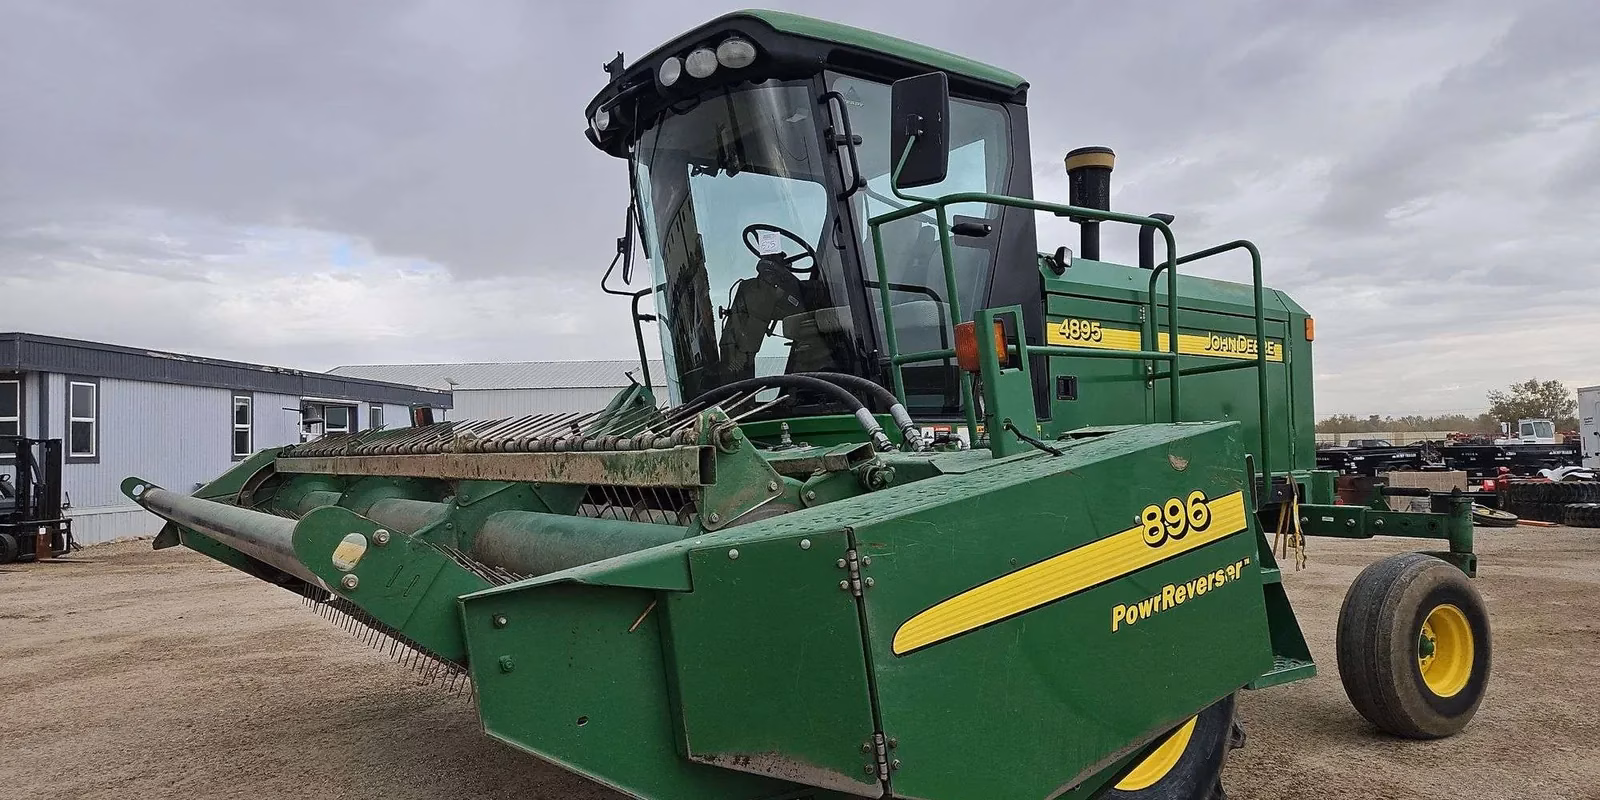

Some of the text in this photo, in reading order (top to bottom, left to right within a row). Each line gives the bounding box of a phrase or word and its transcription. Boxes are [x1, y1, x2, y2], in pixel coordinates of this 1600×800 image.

[1059, 318, 1102, 342] 4895
[1204, 331, 1236, 352] JOHN
[1142, 489, 1211, 548] 896
